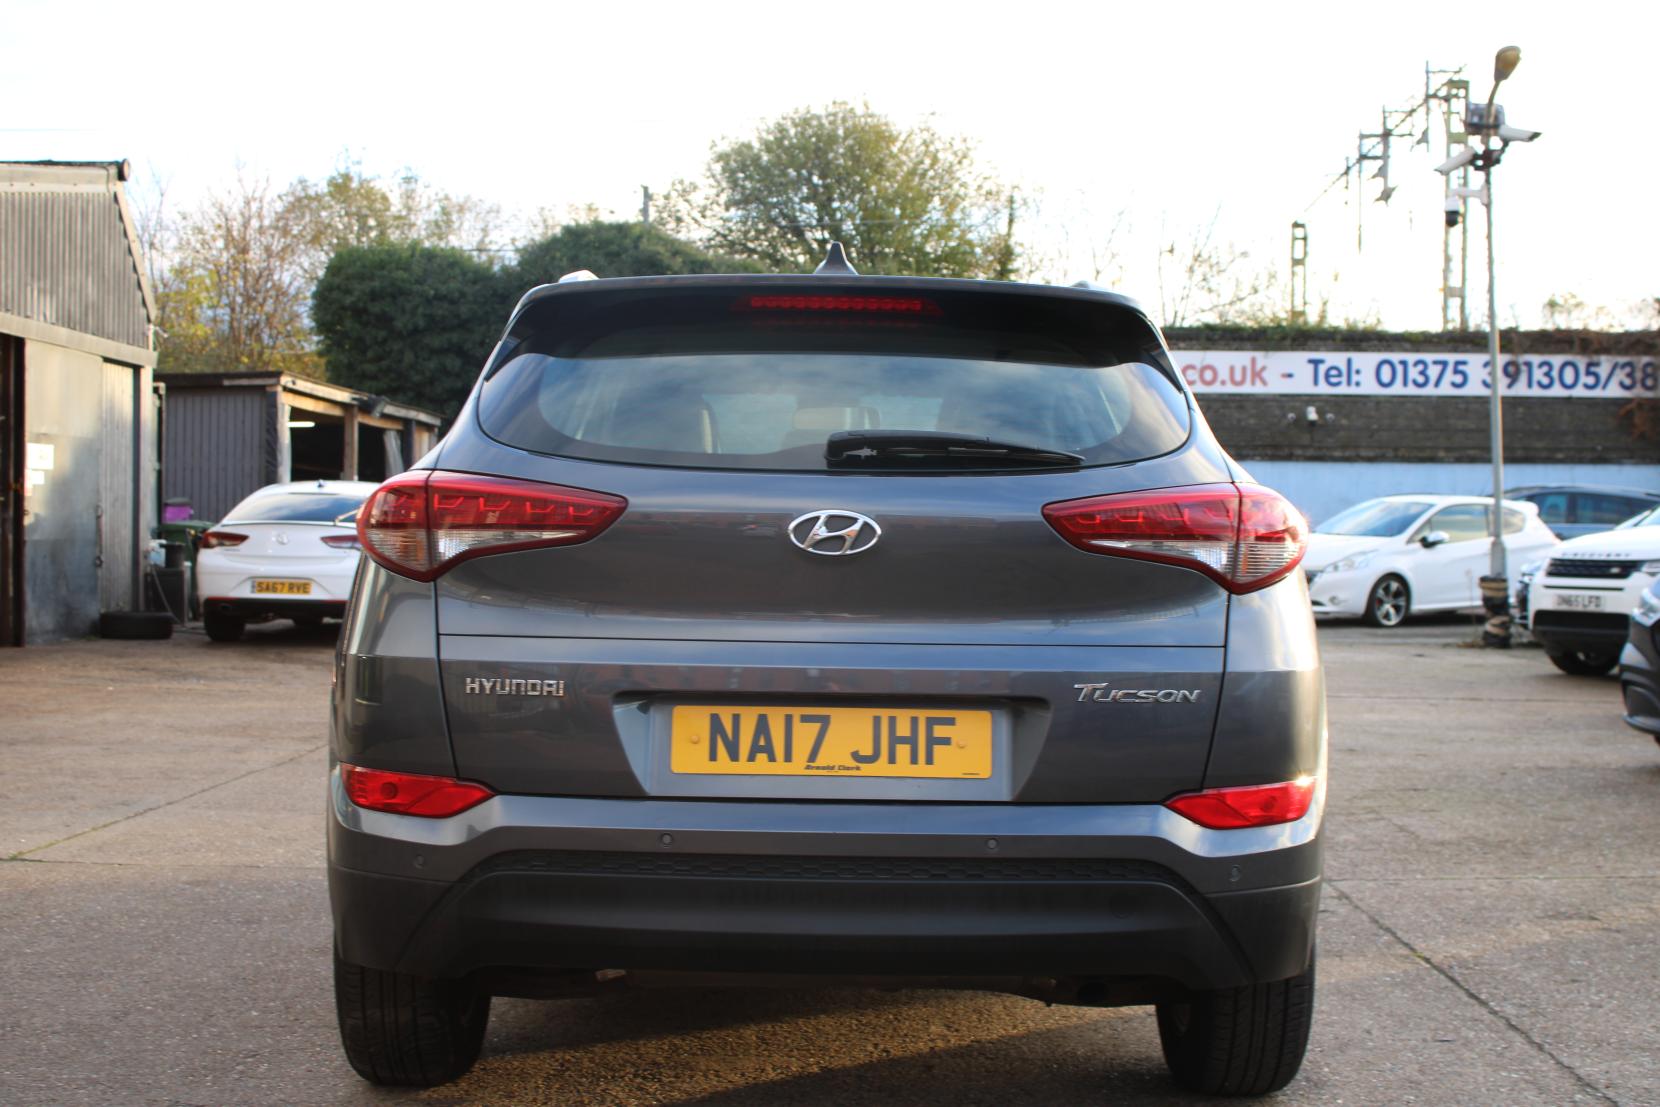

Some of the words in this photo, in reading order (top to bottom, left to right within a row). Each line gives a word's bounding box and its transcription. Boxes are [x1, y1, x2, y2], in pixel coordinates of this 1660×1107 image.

[1307, 357, 1361, 387] Tel:
[1375, 358, 1469, 388] 01375
[465, 677, 565, 697] HYUNDAI
[708, 713, 831, 763] NA17
[850, 715, 956, 765] JHF
